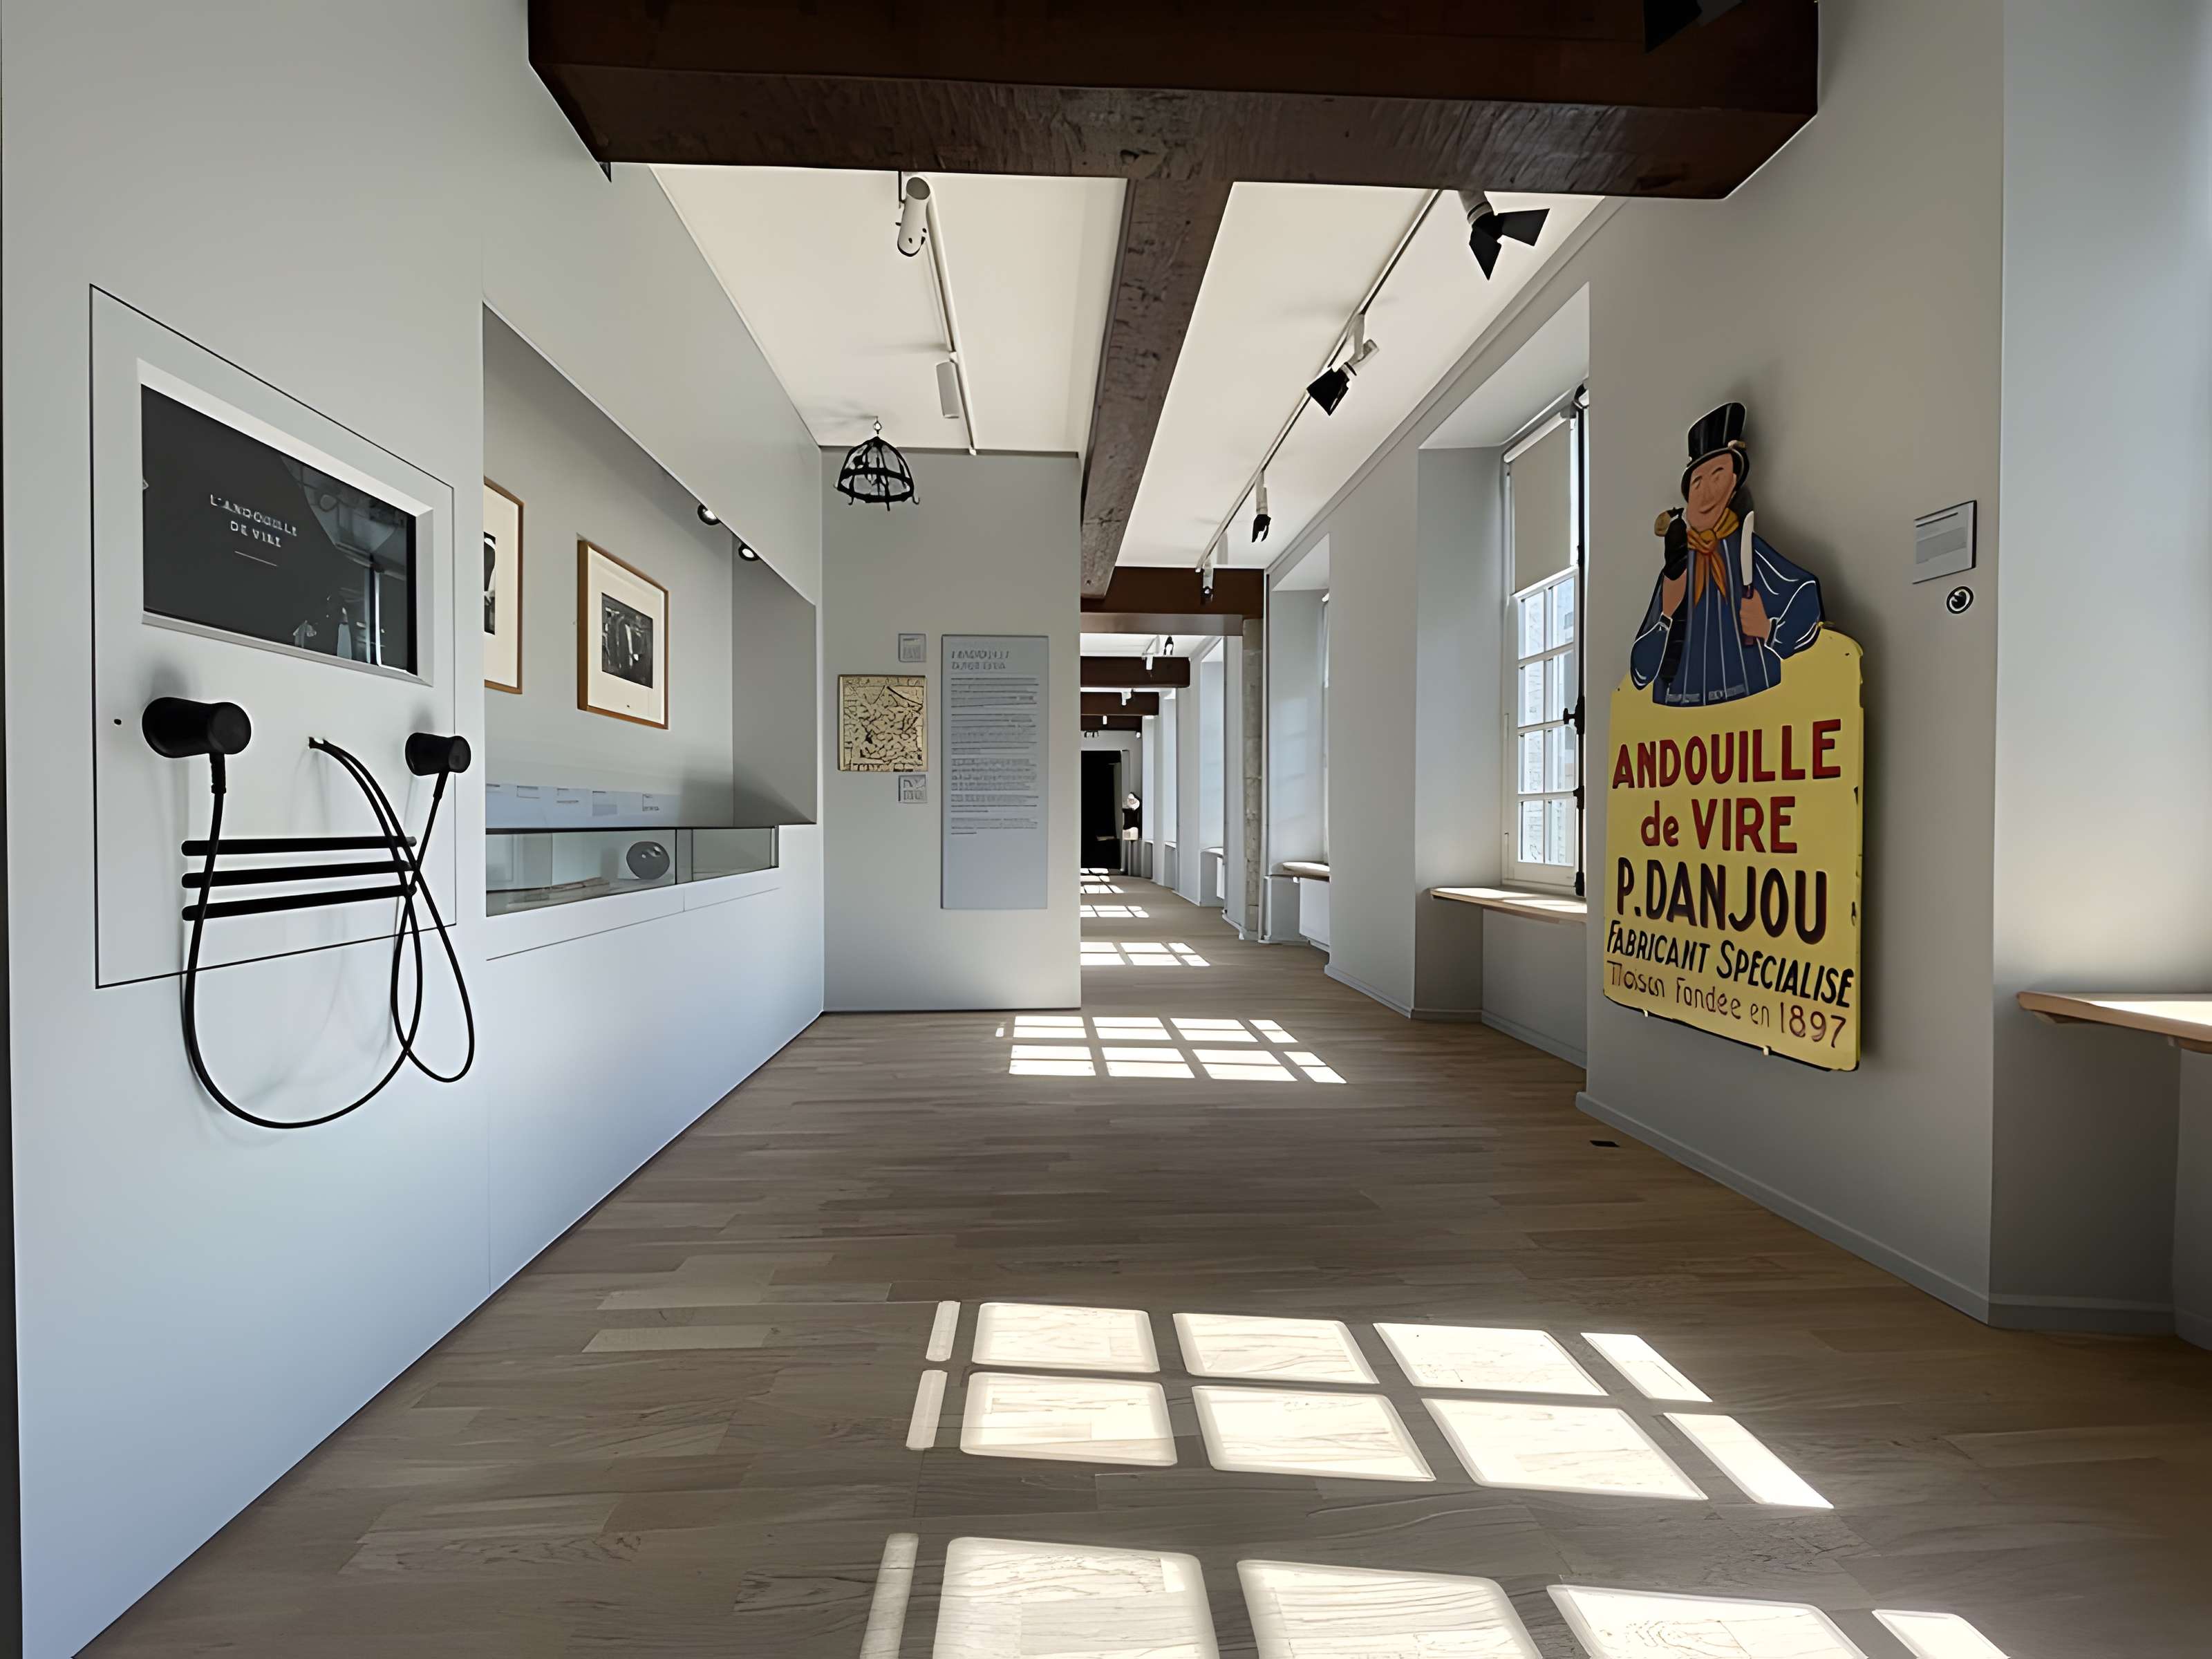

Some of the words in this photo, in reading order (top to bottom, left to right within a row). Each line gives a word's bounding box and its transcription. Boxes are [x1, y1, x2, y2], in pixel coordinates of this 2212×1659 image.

[230, 521, 248, 536] DE
[1611, 718, 1841, 789] ANDOUILLE
[1640, 800, 1679, 847] de
[1691, 796, 1797, 854] VIRE
[1617, 856, 1827, 945] P.DANJOU
[1606, 920, 1710, 973] FABRICANT
[1750, 1003, 1770, 1027] en
[1780, 1002, 1846, 1048] 1897
